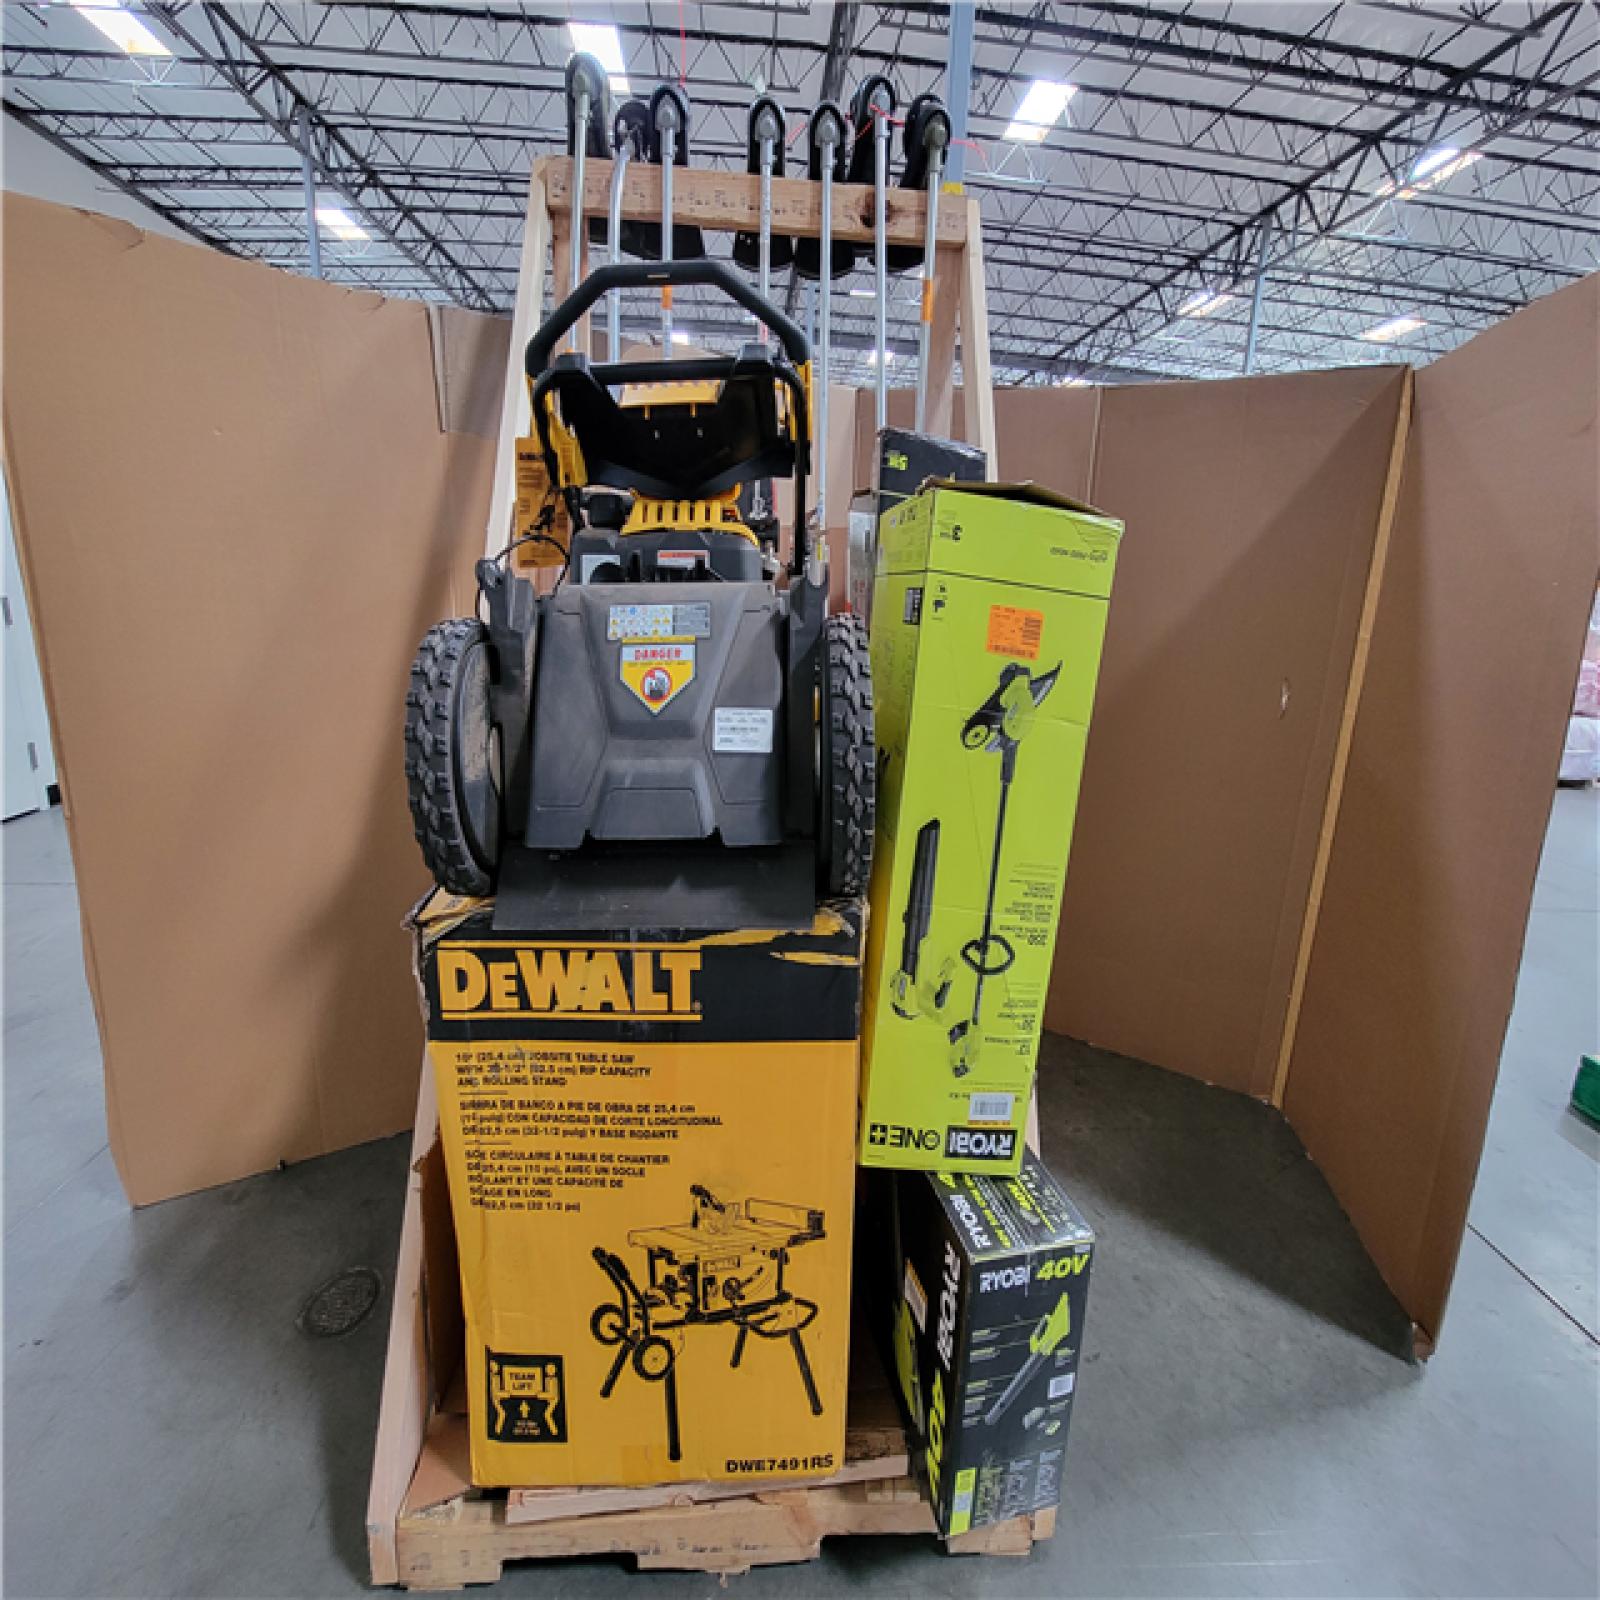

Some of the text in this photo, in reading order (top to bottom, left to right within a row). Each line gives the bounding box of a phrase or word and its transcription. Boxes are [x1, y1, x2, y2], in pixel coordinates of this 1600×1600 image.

[634, 648, 682, 660] DANGER
[950, 1131, 1012, 1156] RYOBI
[980, 1254, 1088, 1293] RYOBI 40V
